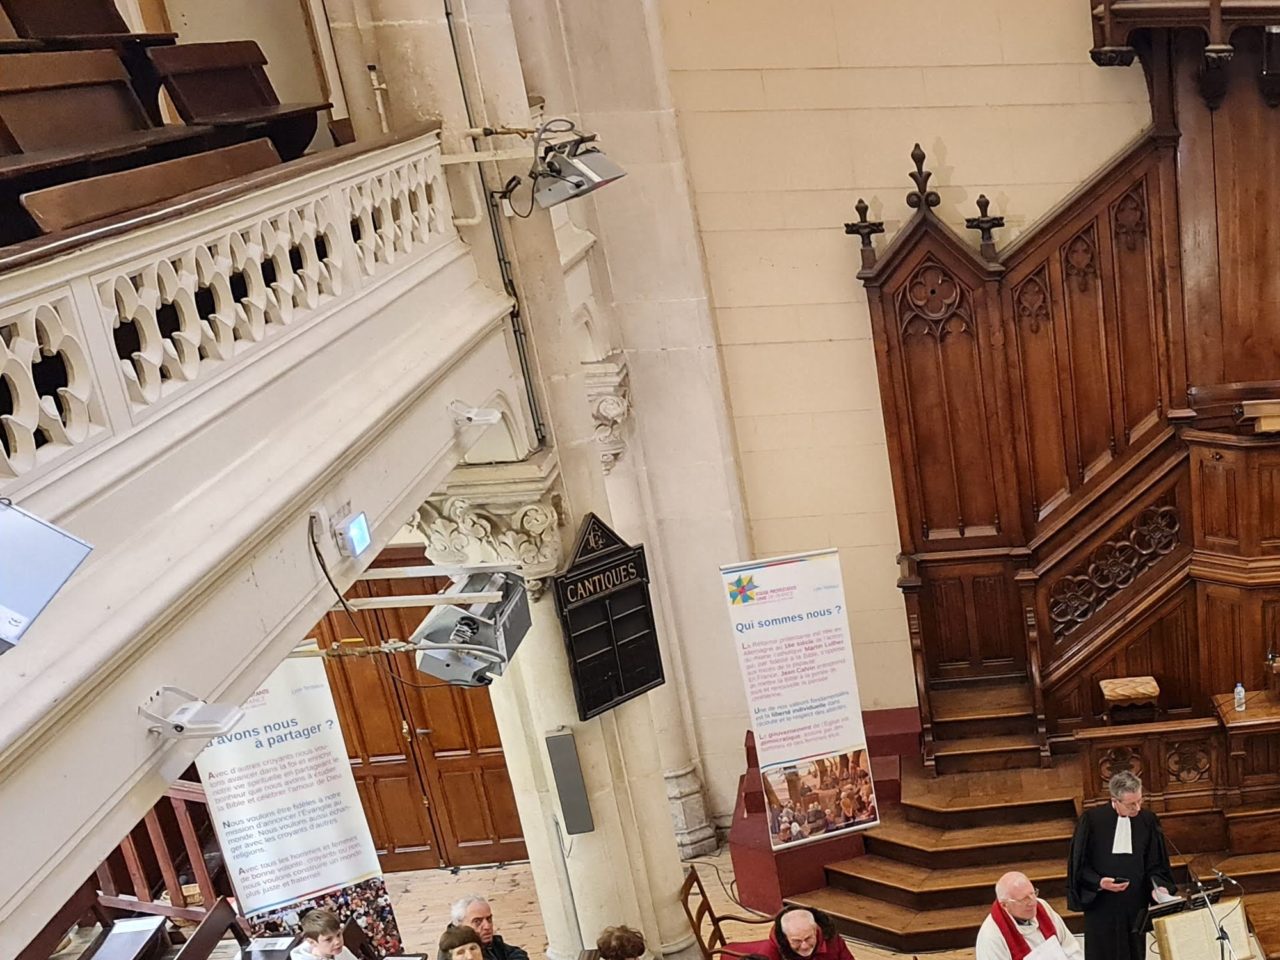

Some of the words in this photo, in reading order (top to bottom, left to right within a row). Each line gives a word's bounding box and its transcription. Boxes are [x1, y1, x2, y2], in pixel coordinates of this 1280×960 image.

[567, 562, 638, 602] CANTIQUES
[735, 620, 754, 632] Qui
[757, 613, 803, 627] sommes
[806, 608, 831, 618] nous
[834, 605, 841, 613] ?
[263, 718, 298, 733] nous
[253, 737, 263, 748] à
[266, 723, 322, 747] partager
[325, 718, 334, 729] ?
[206, 770, 228, 779] Avec
[224, 799, 244, 808] Bible
[222, 819, 243, 828] Nous
[244, 839, 262, 847] avec
[237, 865, 258, 875] Avec
